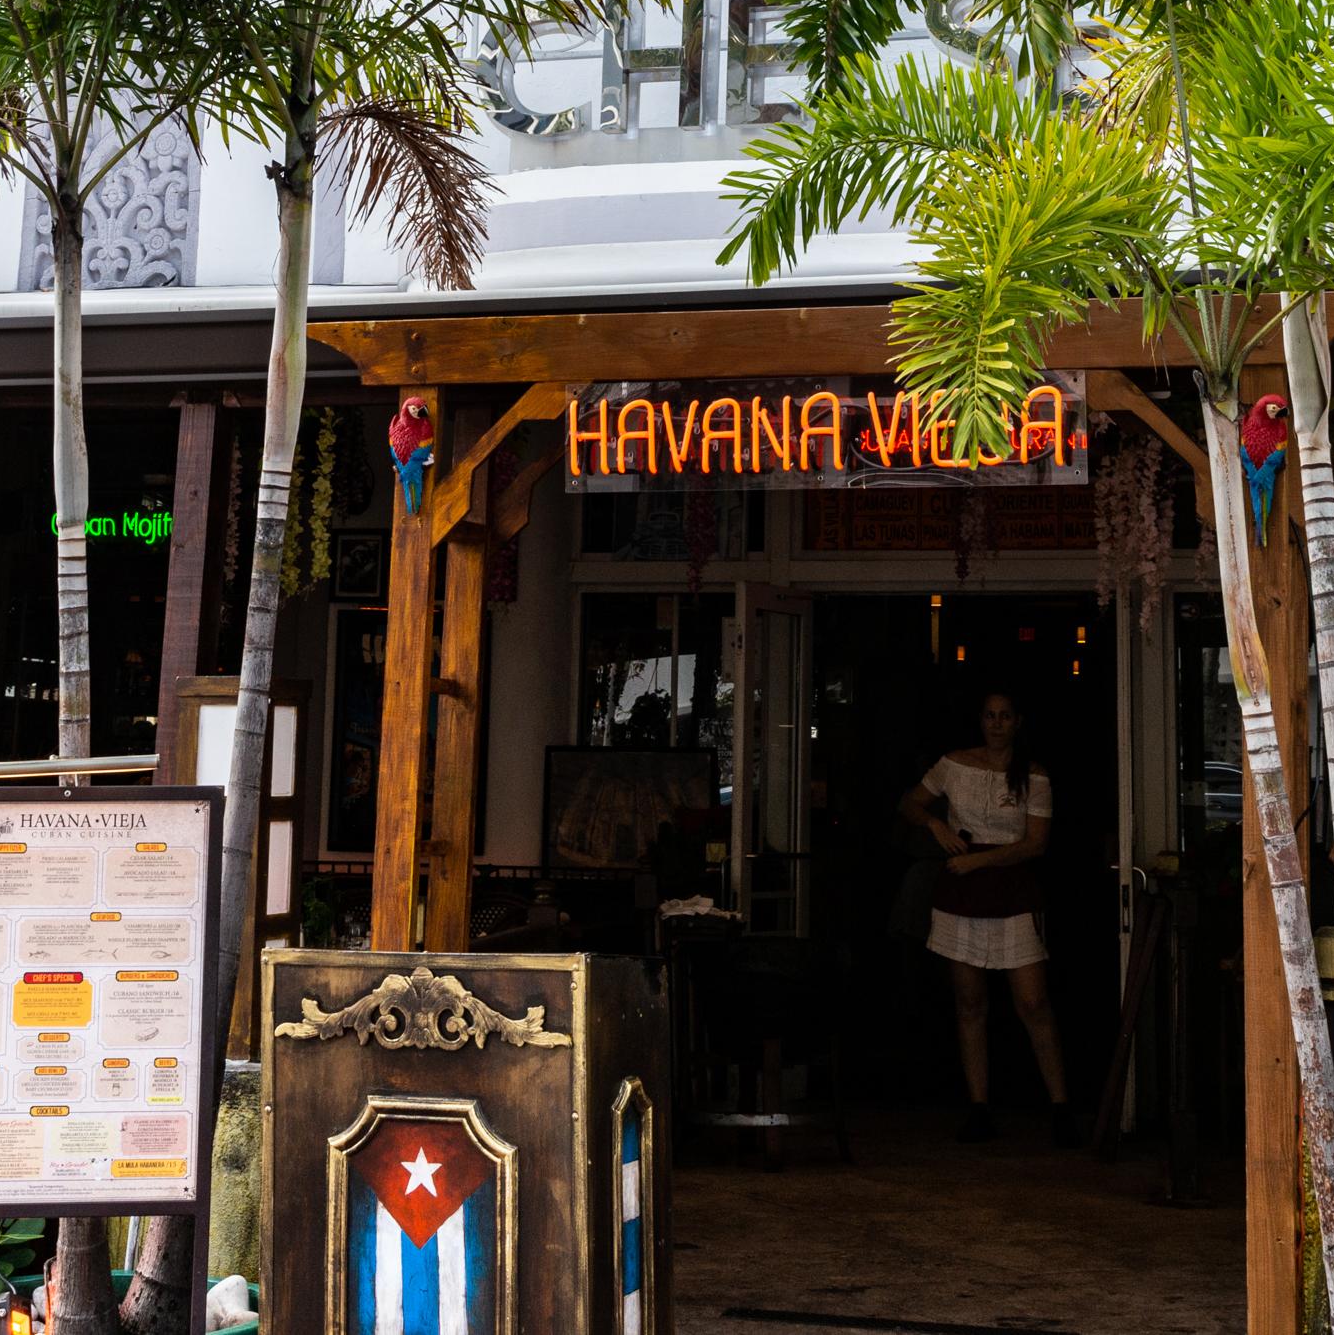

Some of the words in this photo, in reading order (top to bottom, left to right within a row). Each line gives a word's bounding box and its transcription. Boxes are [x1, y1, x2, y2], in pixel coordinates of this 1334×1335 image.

[569, 391, 844, 476] HAVANA
[123, 511, 174, 545] Mojit
[20, 813, 92, 829] HAVANA
[100, 813, 147, 831] VIEJA
[33, 974, 52, 982] CHEF'S
[53, 974, 75, 982] SPECIAL
